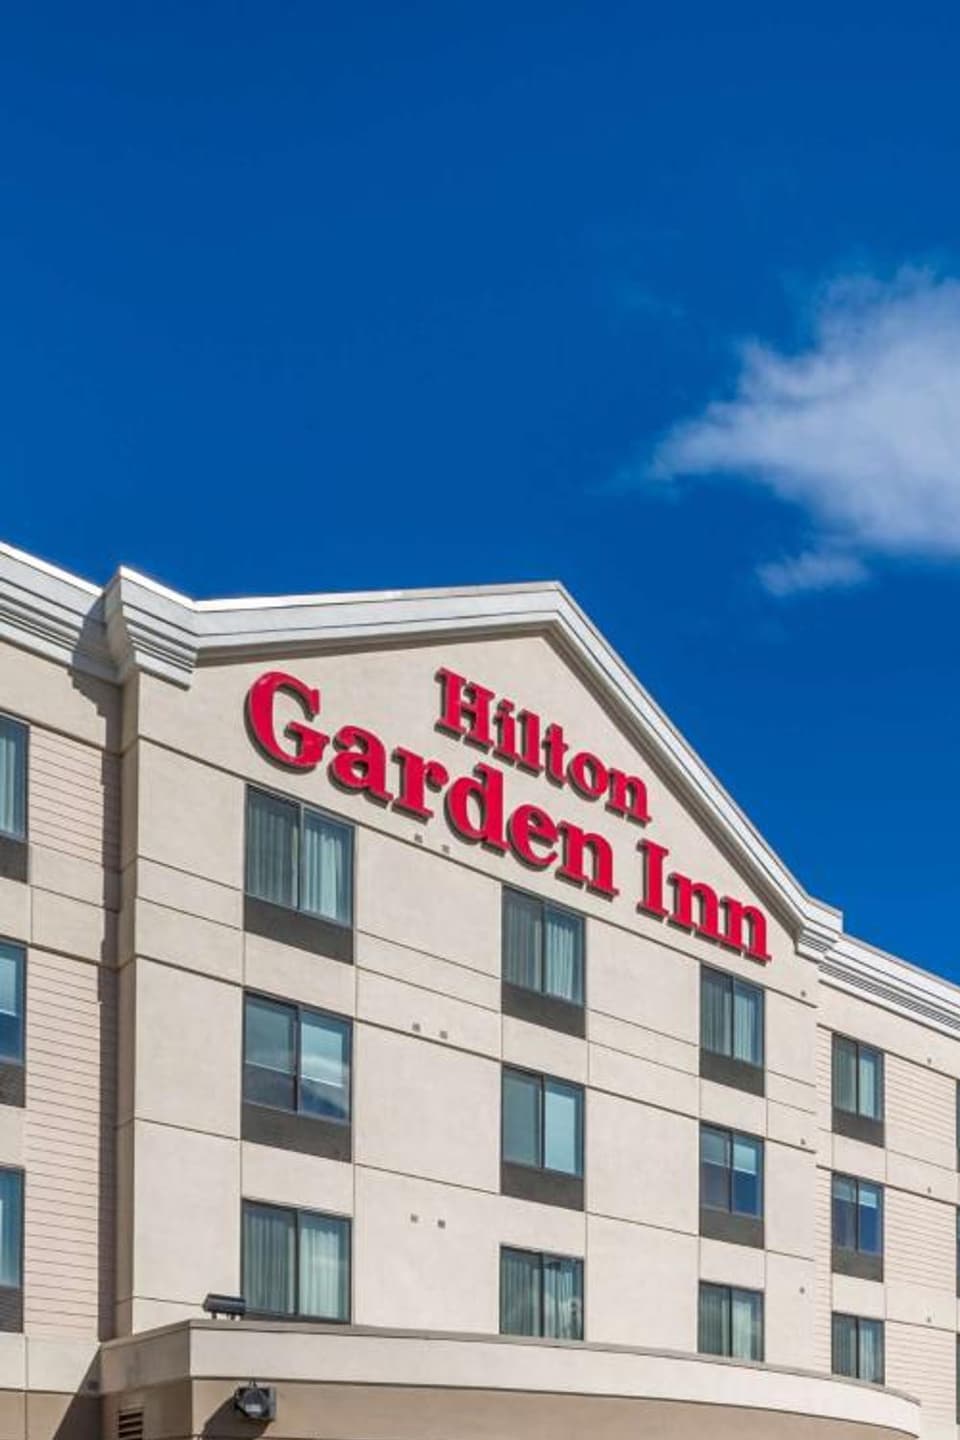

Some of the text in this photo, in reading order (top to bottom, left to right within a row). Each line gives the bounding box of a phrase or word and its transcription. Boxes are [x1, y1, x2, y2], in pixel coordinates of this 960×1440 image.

[247, 669, 772, 962] Garden Inn
[438, 668, 651, 823] Hilton
